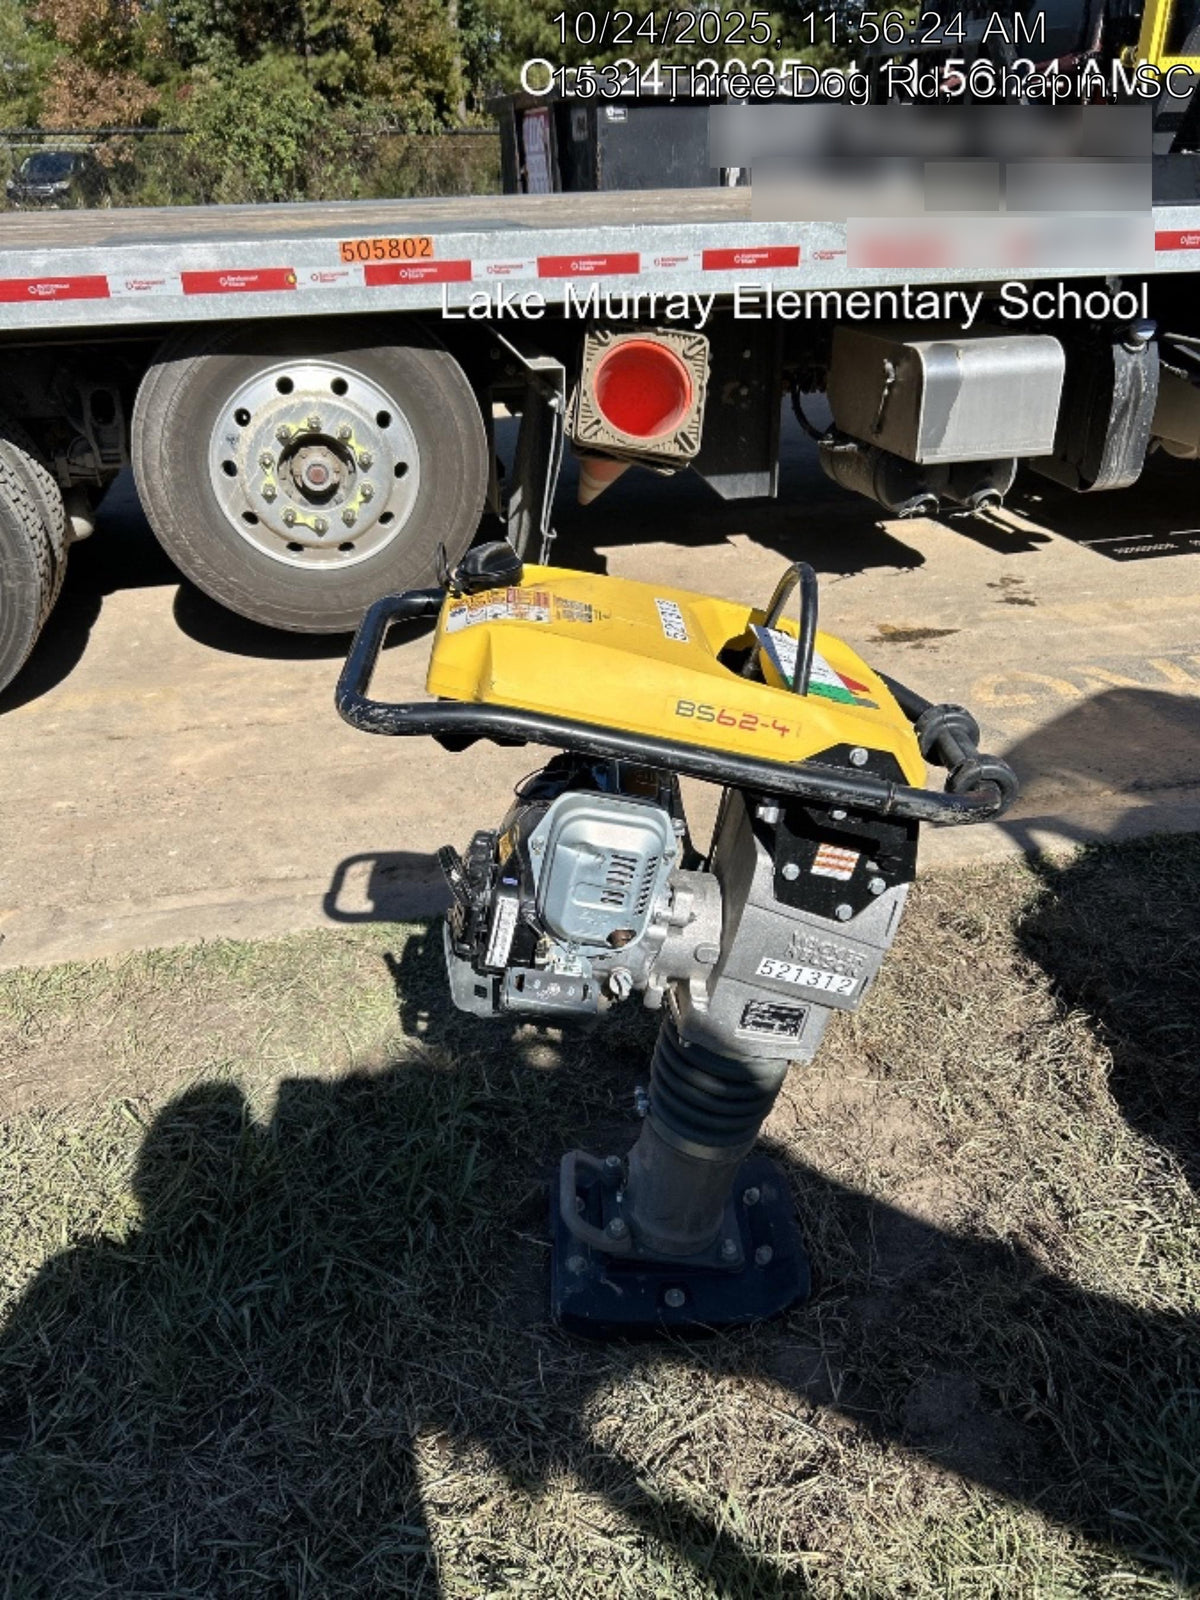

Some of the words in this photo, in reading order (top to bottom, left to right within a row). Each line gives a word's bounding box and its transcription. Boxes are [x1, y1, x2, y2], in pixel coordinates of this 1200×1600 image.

[342, 237, 432, 262] 505802
[675, 700, 790, 738] BS62-4
[760, 959, 853, 993] 521312
